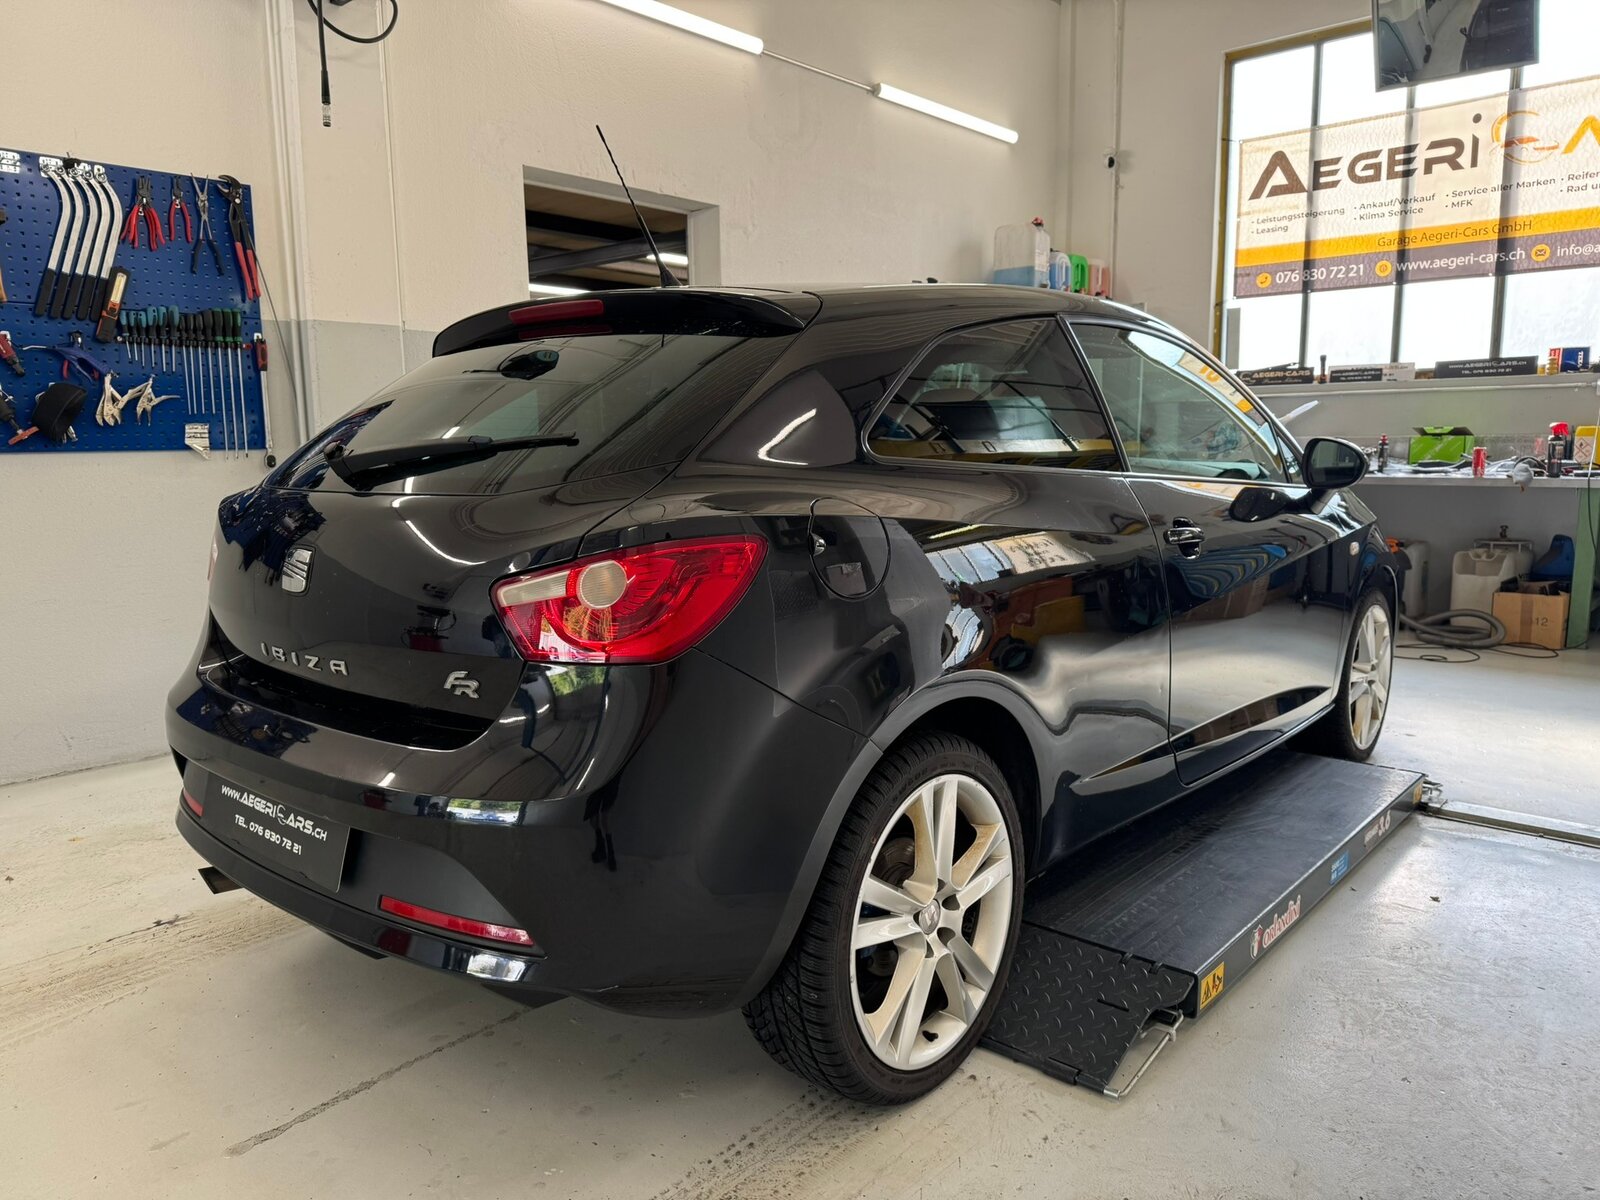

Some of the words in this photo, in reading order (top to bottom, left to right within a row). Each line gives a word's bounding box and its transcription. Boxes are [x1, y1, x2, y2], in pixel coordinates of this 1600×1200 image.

[1451, 187, 1487, 198] Service
[1490, 182, 1513, 193] aller
[1516, 177, 1556, 190] Marken
[1567, 183, 1588, 193] Rad
[1359, 193, 1436, 210] Ankauf/Verkauf
[1451, 200, 1473, 209] MFK
[1256, 207, 1345, 225] Leistungssteigerung
[1359, 210, 1385, 221] Klima
[1388, 206, 1424, 217] Service
[1256, 224, 1289, 235] Leasing
[1377, 234, 1418, 247] Garage
[1420, 226, 1489, 243] Aegeri-Cars
[1491, 220, 1532, 233] GmbH
[1396, 248, 1525, 272] www.aegeri-cars.ch
[1275, 270, 1299, 284] 076
[1302, 268, 1326, 281] 830
[1329, 265, 1346, 278] 72
[1349, 264, 1364, 277] 21
[260, 641, 349, 677] IBIZA
[443, 670, 480, 699] FR
[249, 822, 264, 836] 076
[264, 829, 281, 844] 830
[281, 837, 292, 850] 72
[292, 842, 302, 855] 21
